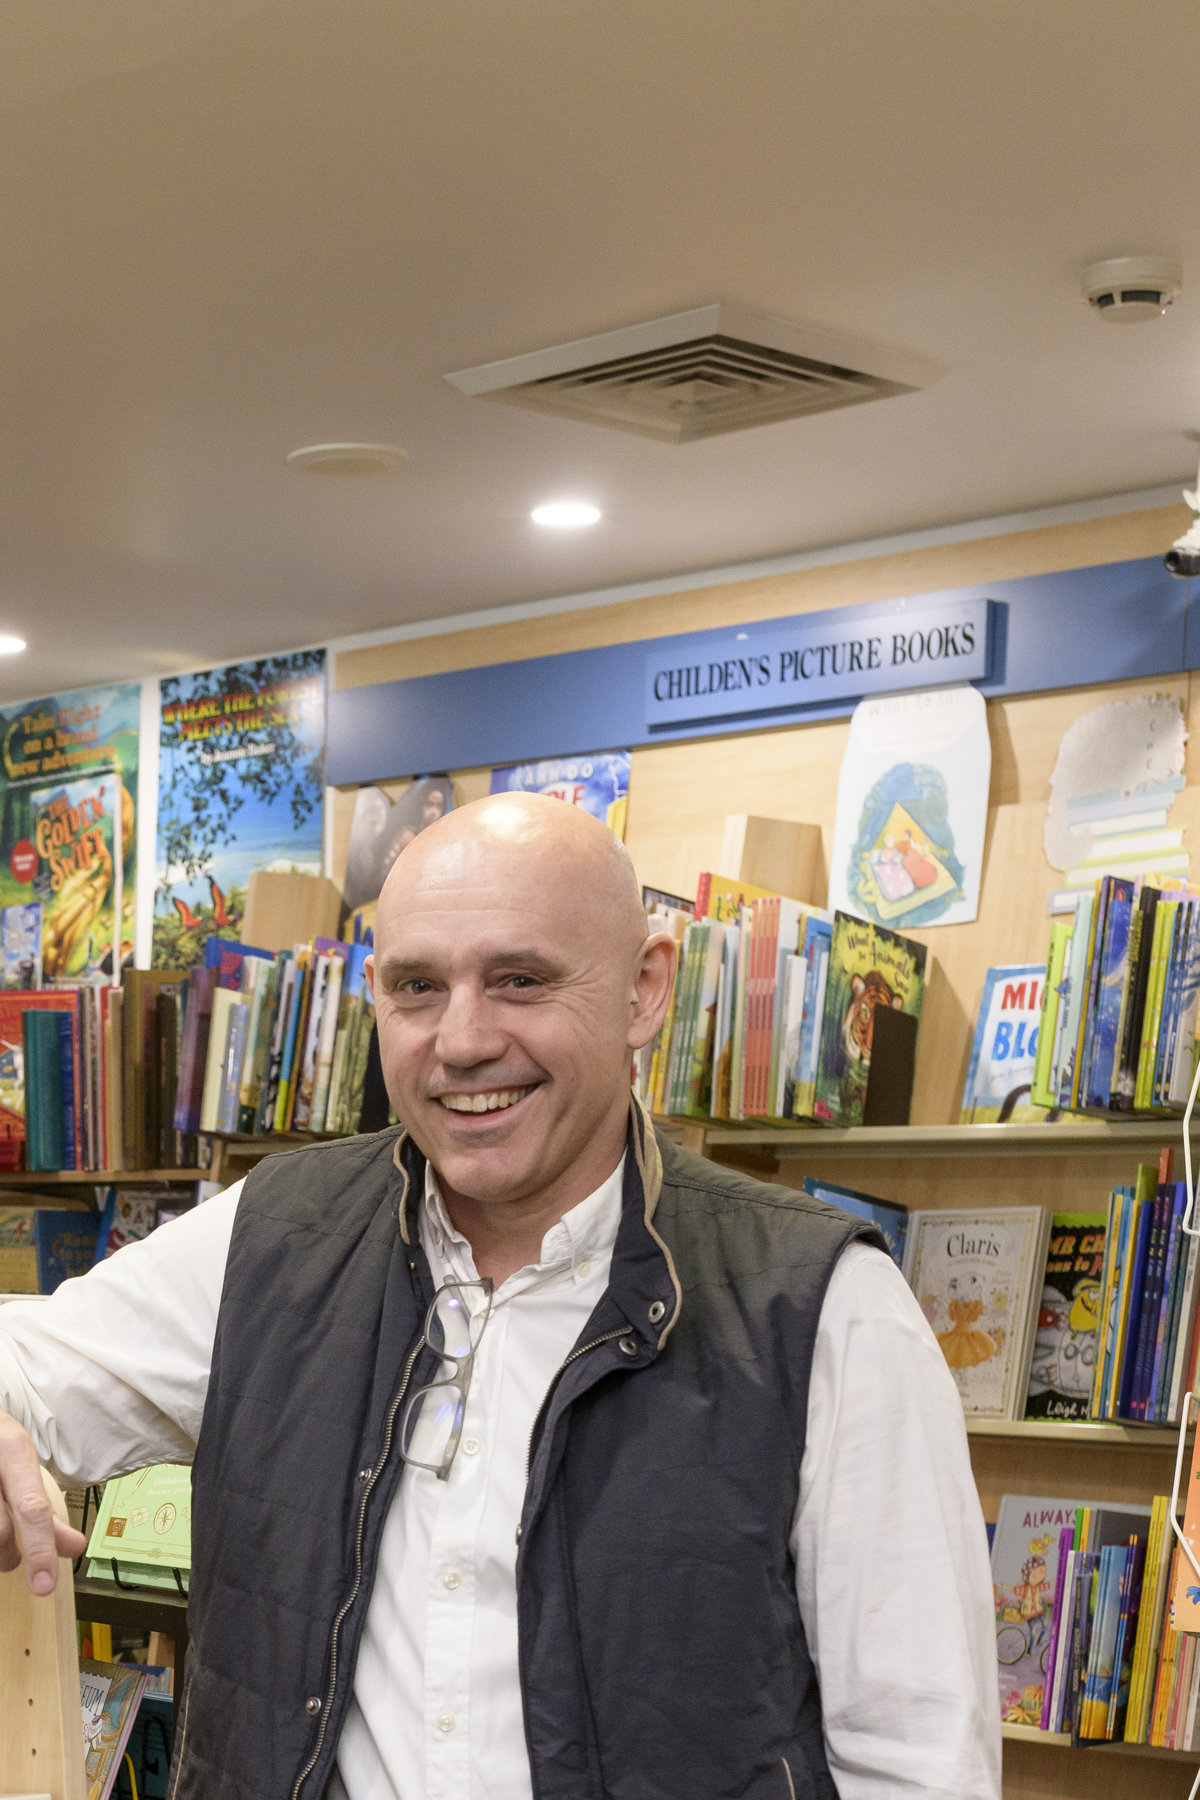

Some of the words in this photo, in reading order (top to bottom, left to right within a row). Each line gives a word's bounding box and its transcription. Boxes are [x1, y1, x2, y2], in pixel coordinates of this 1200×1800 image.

[653, 653, 772, 701] CHILDEN'S
[778, 637, 882, 683] PICTURE
[890, 622, 975, 667] BOOKS
[22, 713, 55, 734] Take
[162, 699, 221, 725] WHERE
[223, 693, 255, 716] THE
[24, 740, 41, 754] on
[44, 737, 54, 750] a
[56, 724, 98, 747] brand
[179, 713, 233, 742] MEETS
[236, 710, 266, 733] THE
[10, 761, 39, 776] new
[36, 797, 105, 859] GOLDEN
[50, 827, 104, 892] SWIFT
[947, 1232, 1001, 1259] Claris
[1046, 1400, 1071, 1418] Leigh
